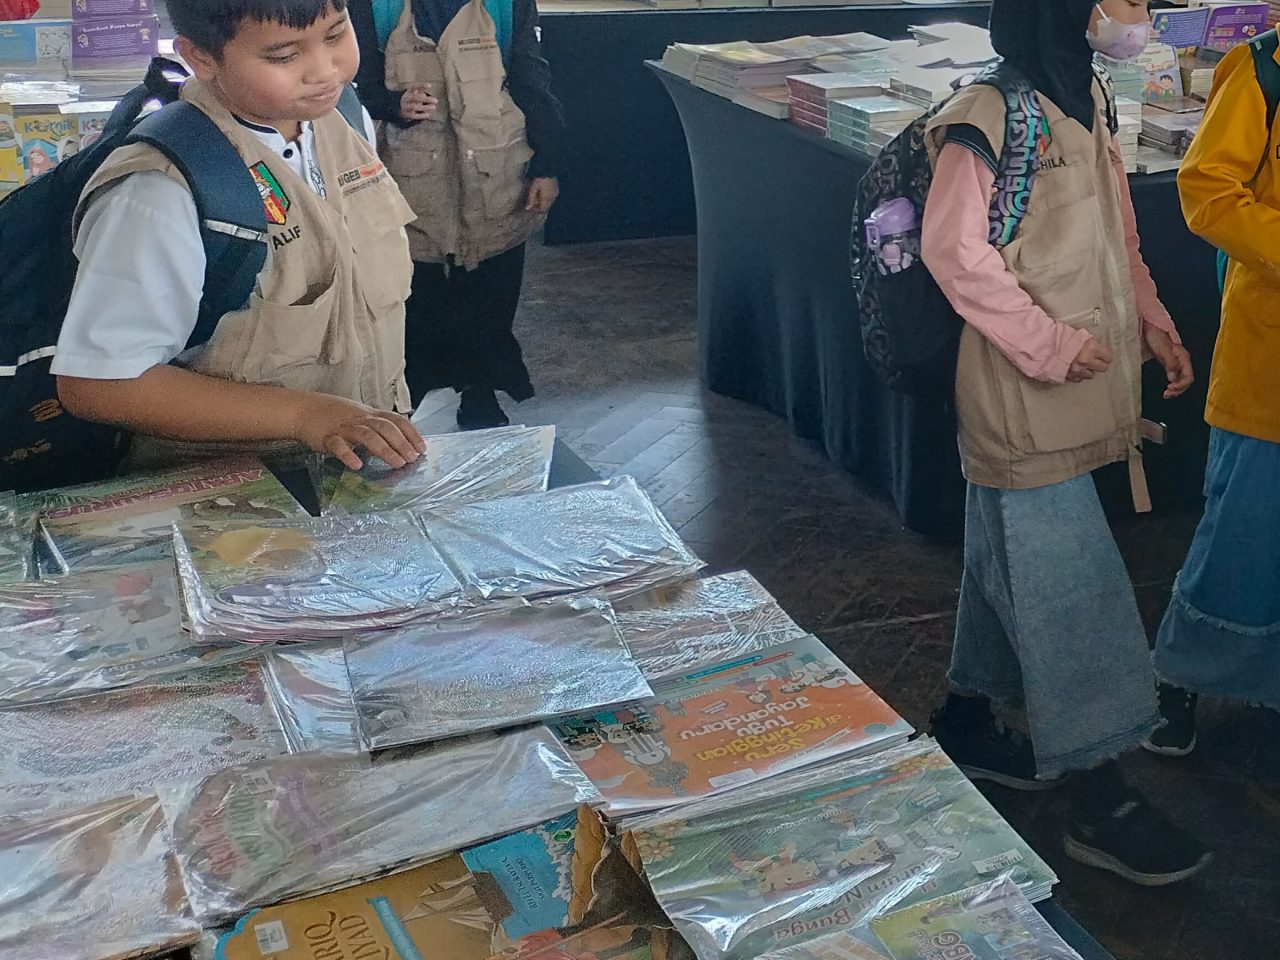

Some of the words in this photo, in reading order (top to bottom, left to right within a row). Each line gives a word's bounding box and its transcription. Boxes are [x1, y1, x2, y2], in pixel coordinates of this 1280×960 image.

[271, 225, 301, 251] ALIF
[678, 695, 813, 741] Jayandaru
[736, 714, 795, 738] Tugu
[744, 737, 807, 763] Seru
[303, 910, 345, 960] RIQ
[338, 914, 390, 960] IYAD
[773, 906, 852, 941] Bunga
